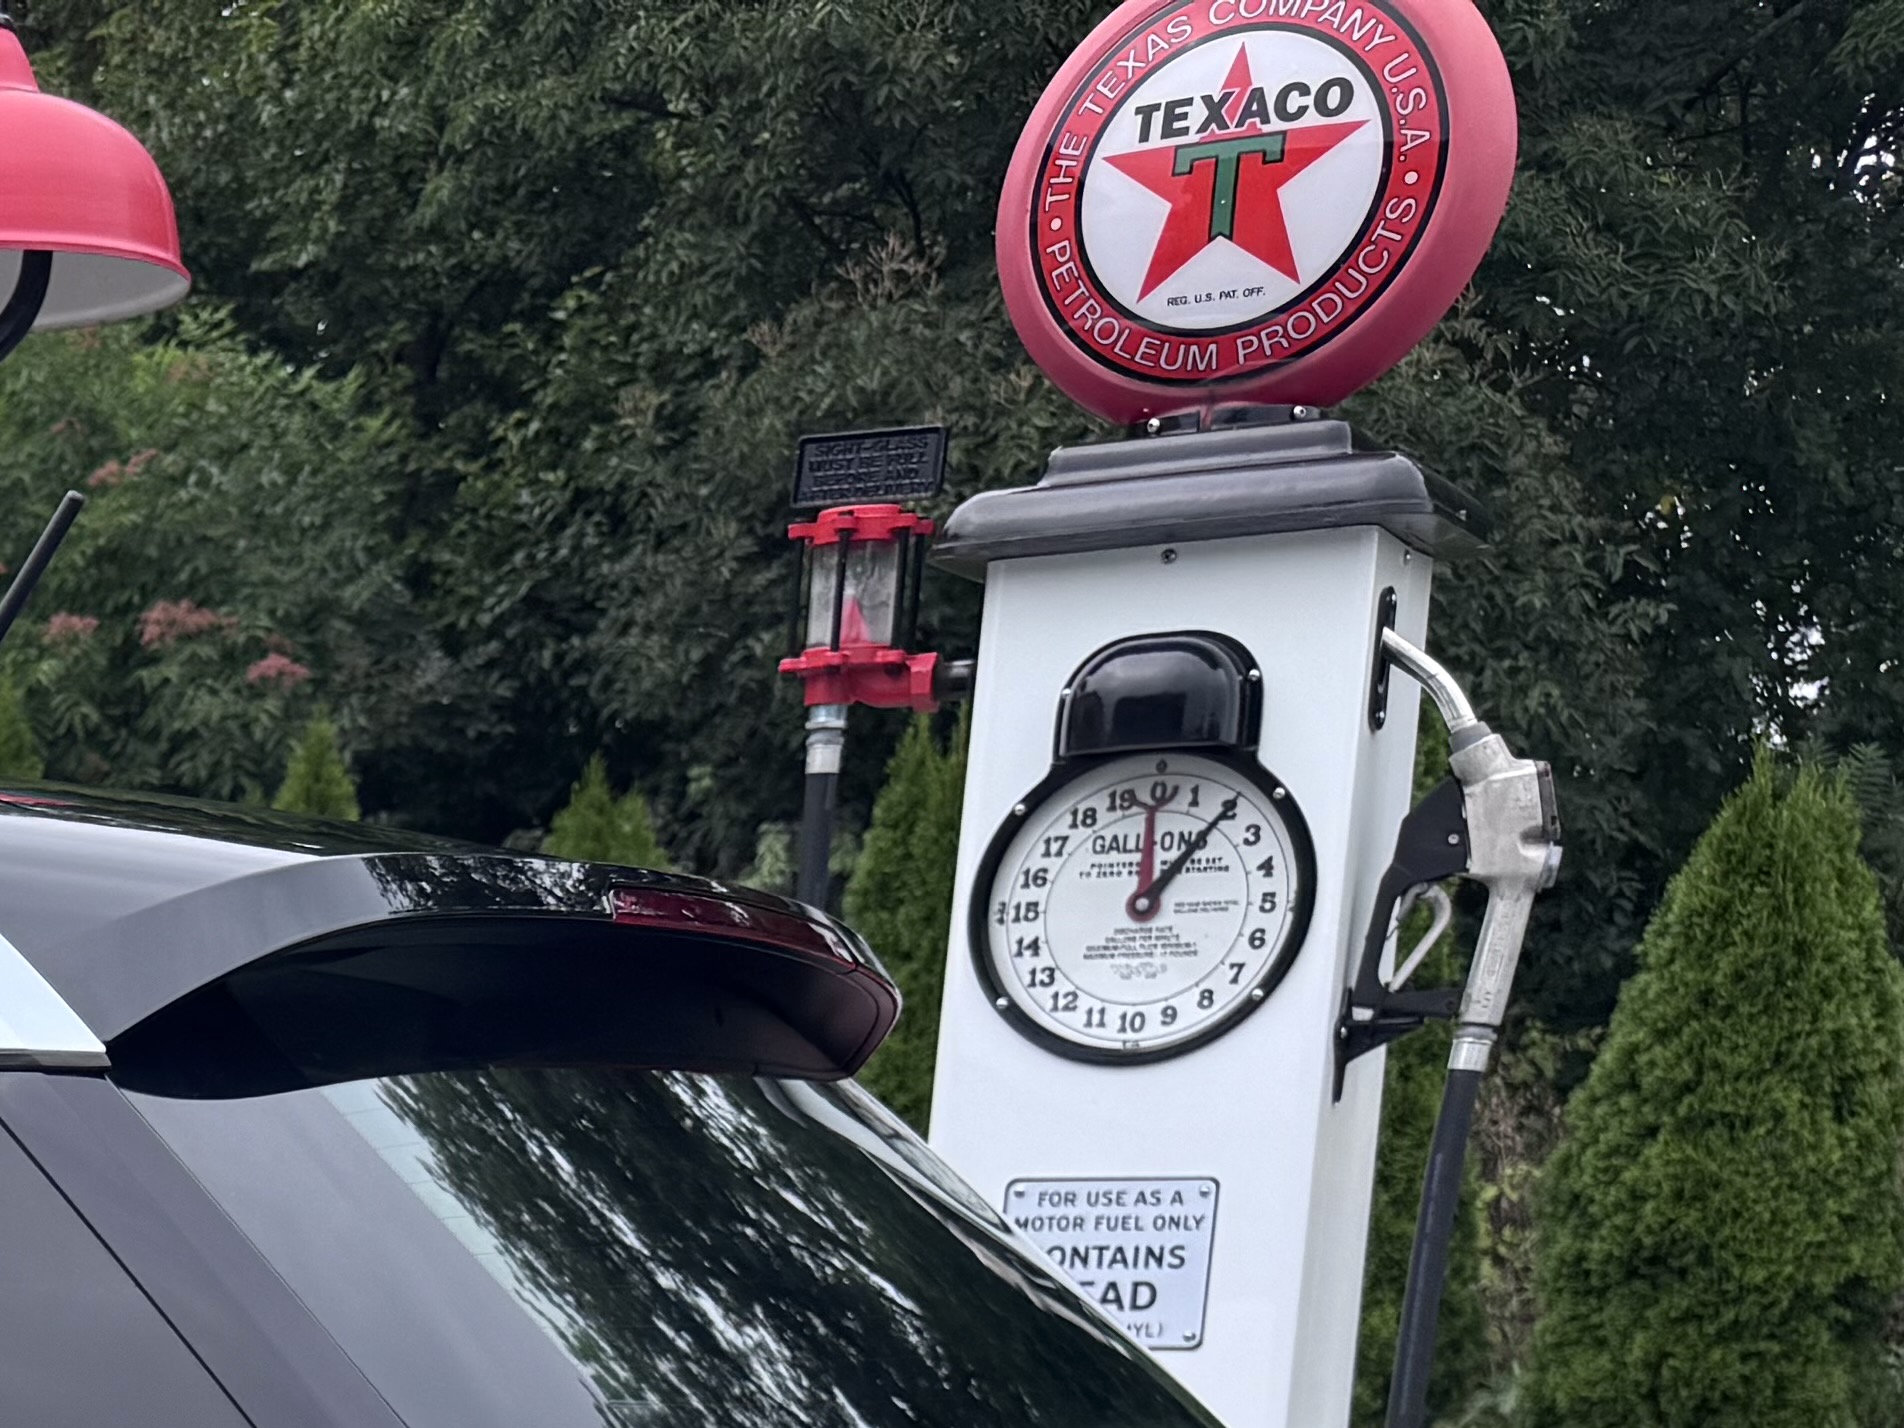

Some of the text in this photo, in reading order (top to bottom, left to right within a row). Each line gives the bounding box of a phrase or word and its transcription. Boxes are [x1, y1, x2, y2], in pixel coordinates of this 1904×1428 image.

[1045, 0, 1431, 212] THE TEXAS COMPANY U.S.A.
[1134, 77, 1355, 144] TEXACO
[1046, 197, 1418, 371] PETROLEUM PRODUCTS
[1106, 788, 1137, 812] 19
[1187, 784, 1200, 808] 1
[1068, 807, 1098, 830] 18
[1040, 834, 1071, 858] 17
[1242, 823, 1262, 846] 3
[1020, 867, 1049, 889] 16
[1256, 855, 1275, 878] 4
[1011, 901, 1040, 923] 15
[1259, 891, 1276, 914] 5
[1013, 936, 1040, 957] 14
[1247, 927, 1266, 950] 6
[1026, 966, 1056, 988] 13
[1228, 962, 1246, 985] 7
[1049, 991, 1079, 1012] 12
[1196, 988, 1214, 1010] 8
[1083, 1006, 1107, 1028] 11
[1116, 1011, 1146, 1034] 10
[1160, 1005, 1178, 1026] 9
[1036, 1189, 1185, 1208] FOR USE AS A
[1013, 1213, 1206, 1232] MOTOR FUEL ONLY
[1045, 1245, 1187, 1270] ONTAINS
[1079, 1280, 1158, 1312] AD
